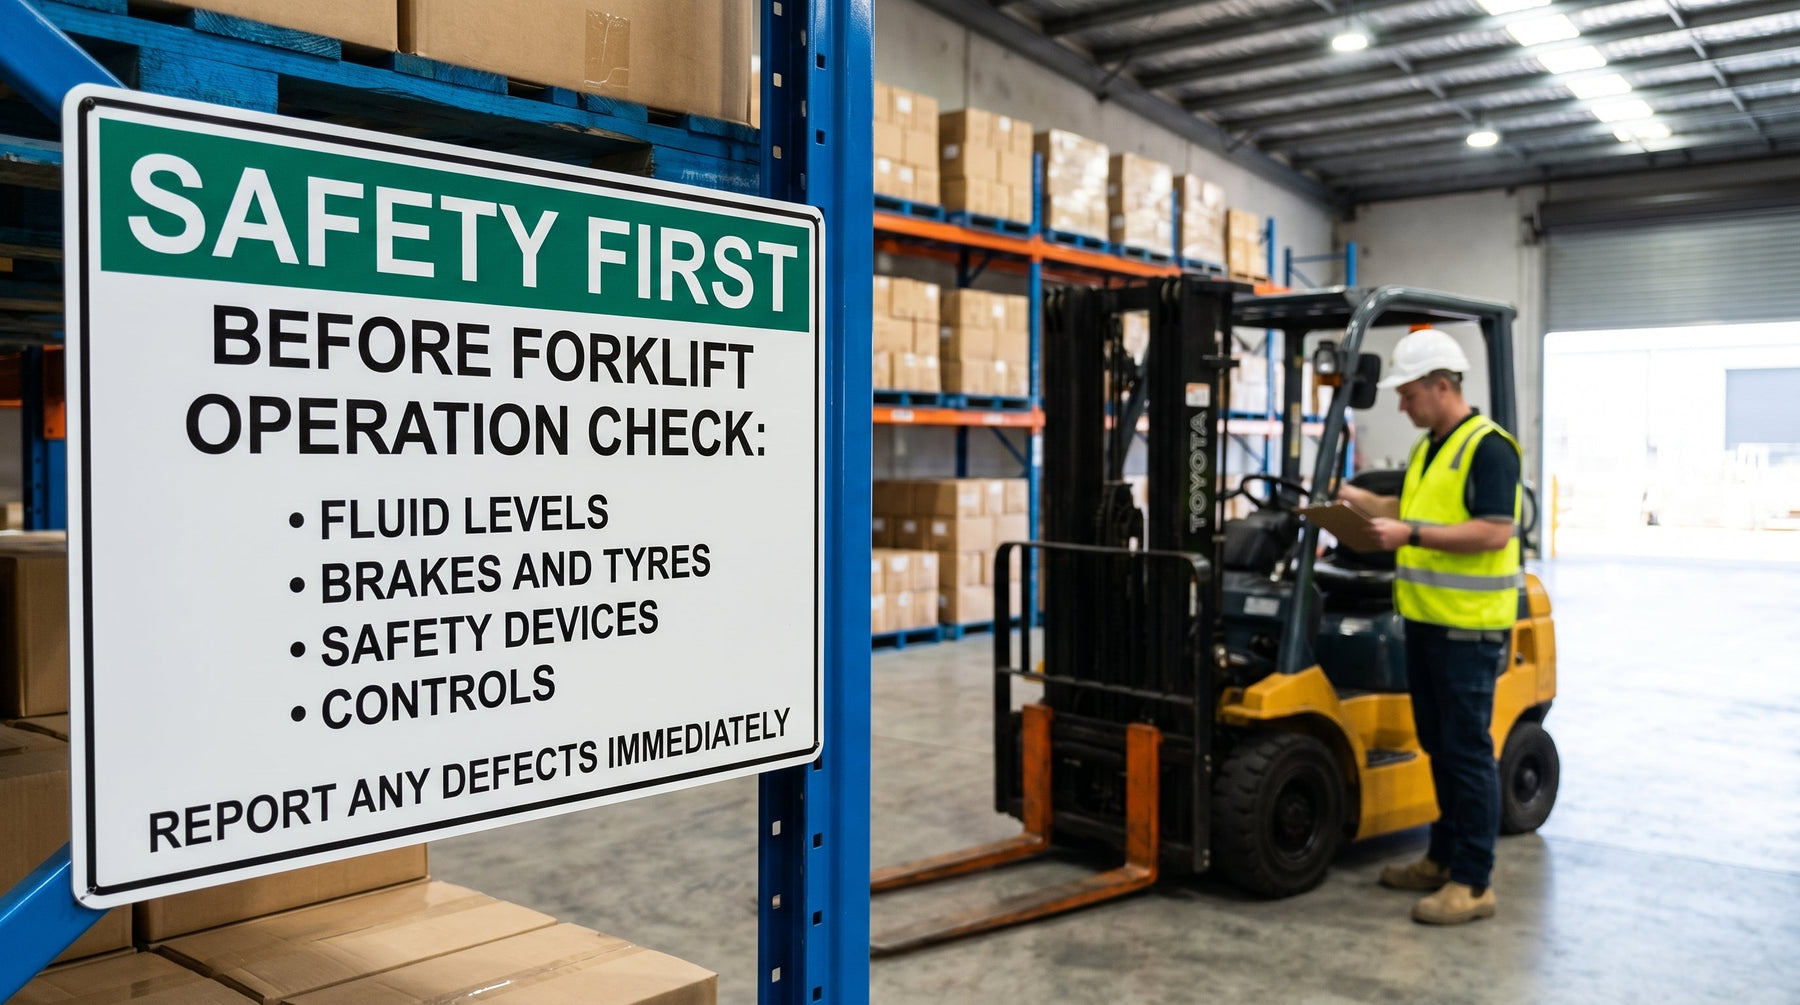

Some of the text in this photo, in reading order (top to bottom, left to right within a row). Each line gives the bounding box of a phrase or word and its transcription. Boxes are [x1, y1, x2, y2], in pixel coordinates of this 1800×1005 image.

[128, 154, 797, 311] SAFETY FIRST
[214, 305, 753, 389] BEFORE FORKLIFT
[186, 394, 764, 456] OPERATION CHECK:
[1189, 410, 1208, 534] TOYOTA
[322, 494, 608, 539] FLUID LEVELS
[322, 544, 710, 603] BRAKES AND TYRES
[322, 600, 658, 666] SAFETY DEVICES
[322, 665, 555, 729] CONTROLS
[150, 707, 790, 853] REPORT ANY DEFECTS IMMEDIATELY
